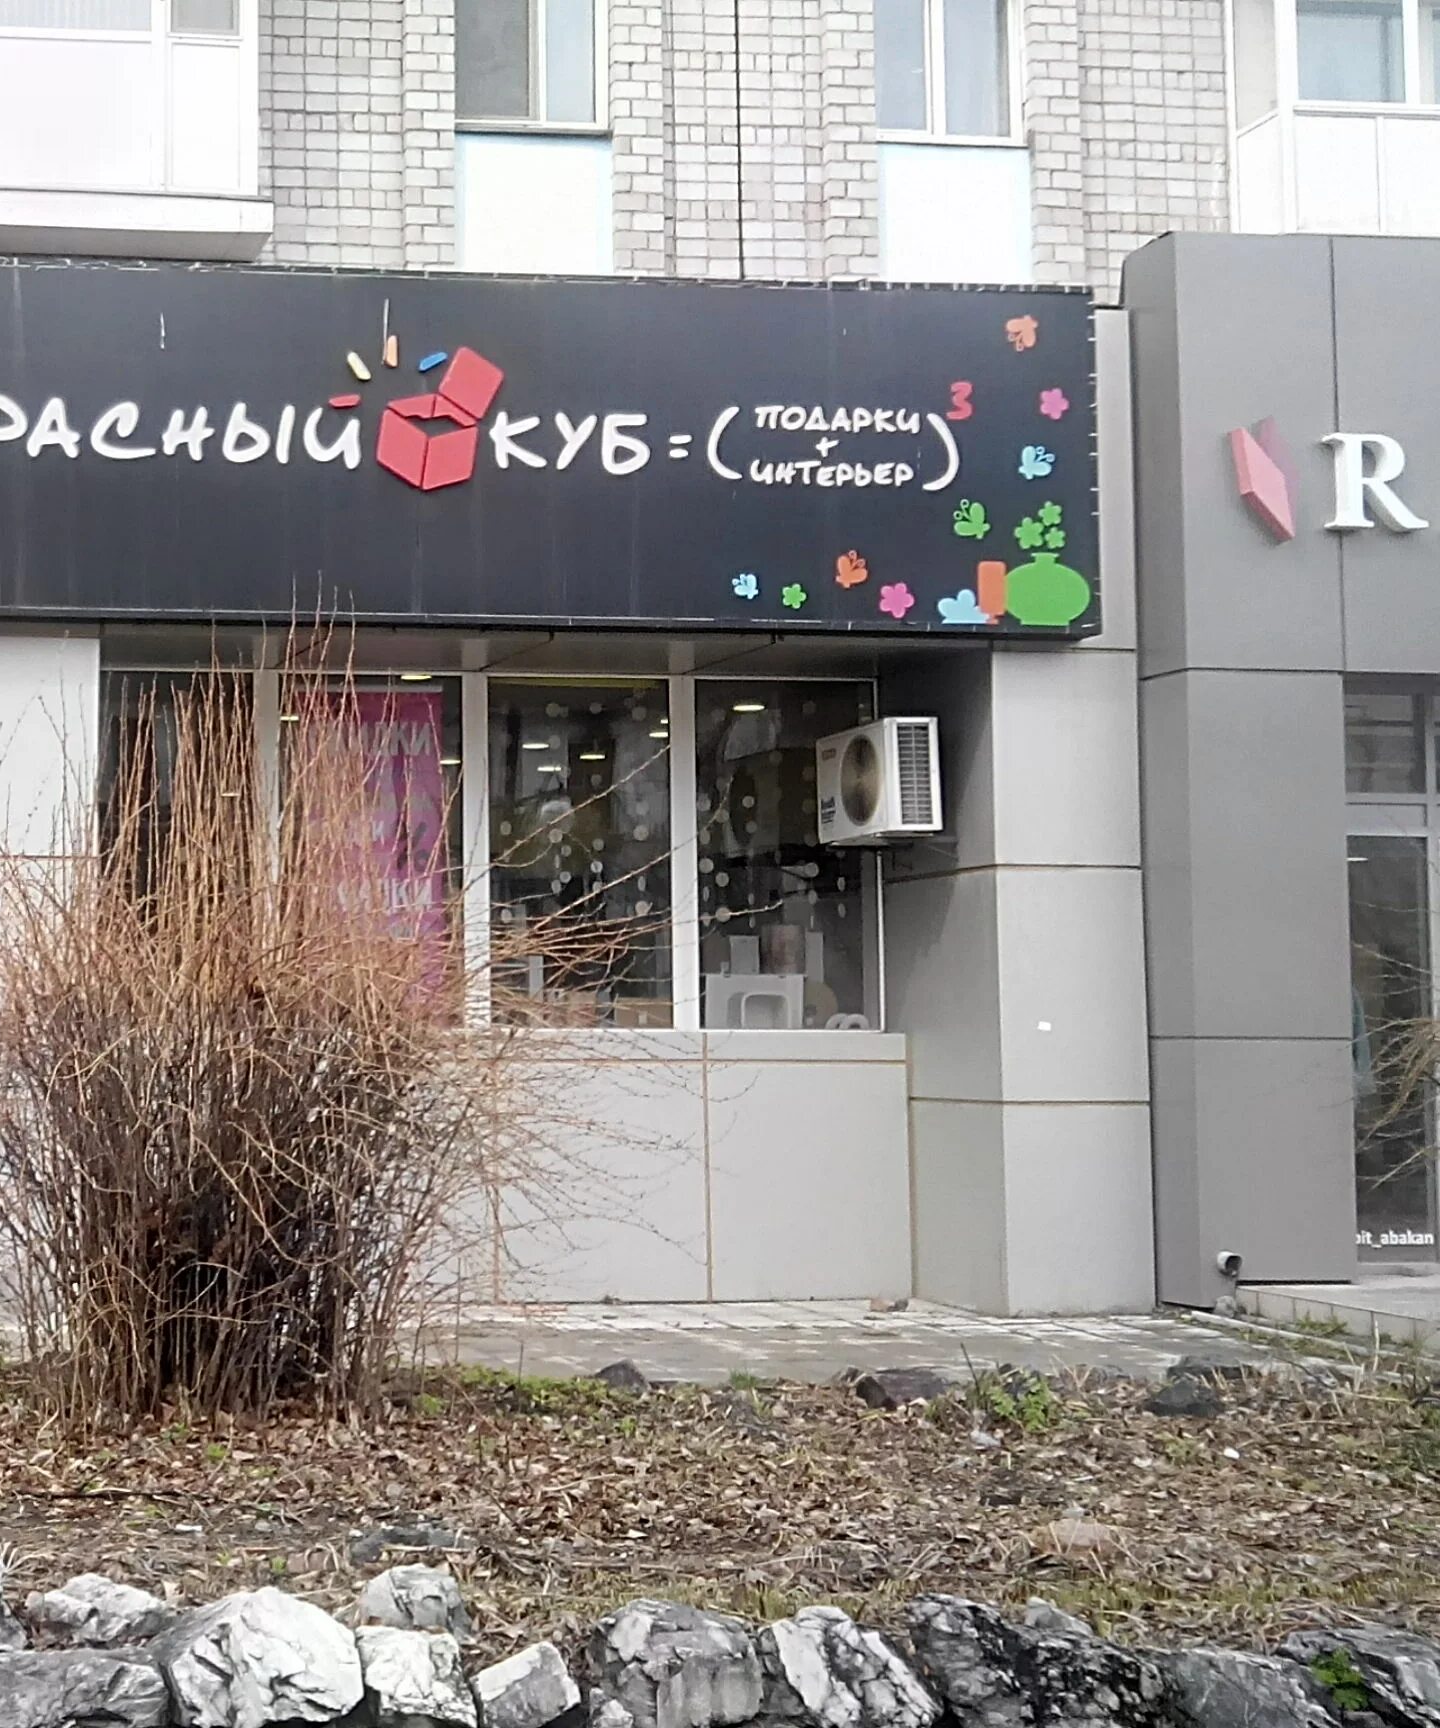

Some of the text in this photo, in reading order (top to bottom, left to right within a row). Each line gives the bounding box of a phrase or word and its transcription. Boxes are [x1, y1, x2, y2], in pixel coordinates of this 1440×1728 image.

[754, 405, 920, 434] ПОДАРКИ
[488, 412, 651, 476] КУБ
[749, 458, 914, 487] ИНТЕРЬЕР
[1318, 432, 1430, 532] R
